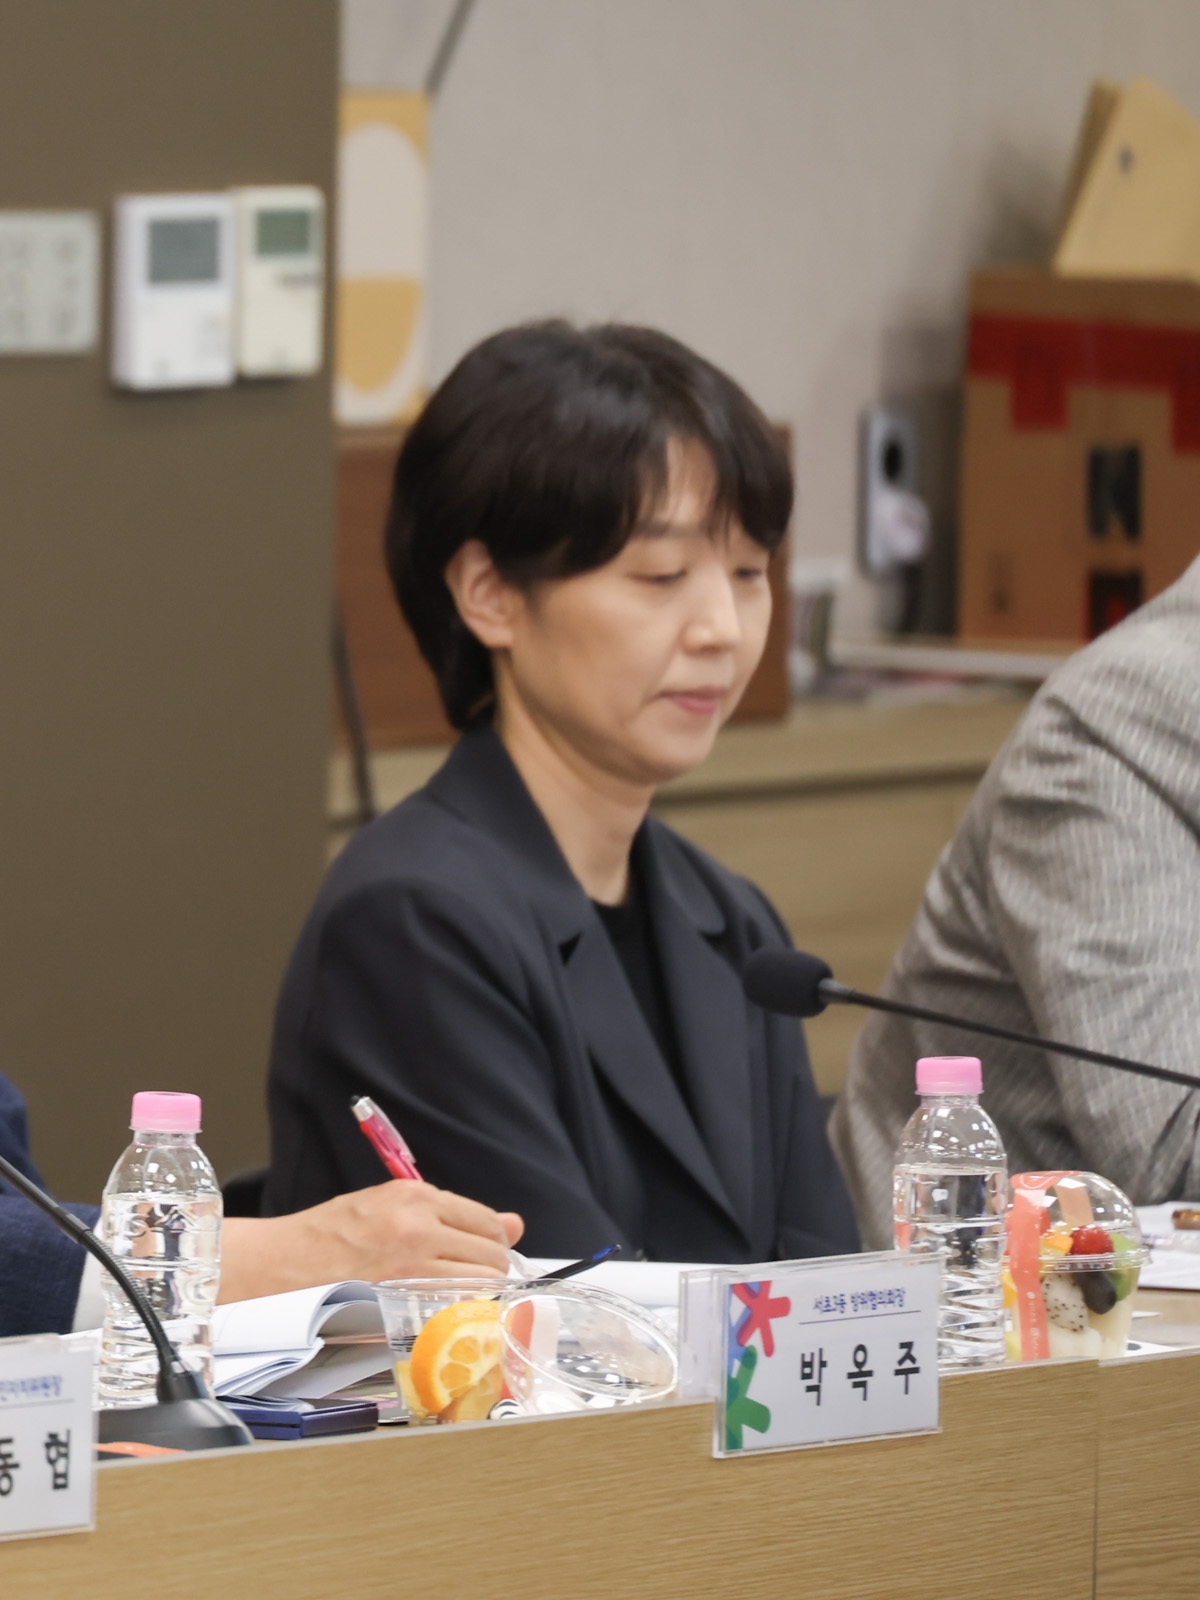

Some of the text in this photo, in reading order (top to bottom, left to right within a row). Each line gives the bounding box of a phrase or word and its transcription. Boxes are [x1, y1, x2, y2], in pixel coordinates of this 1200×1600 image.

[813, 1287, 906, 1314] 서초3동 방위협의회장
[799, 1340, 920, 1406] 박옥주
